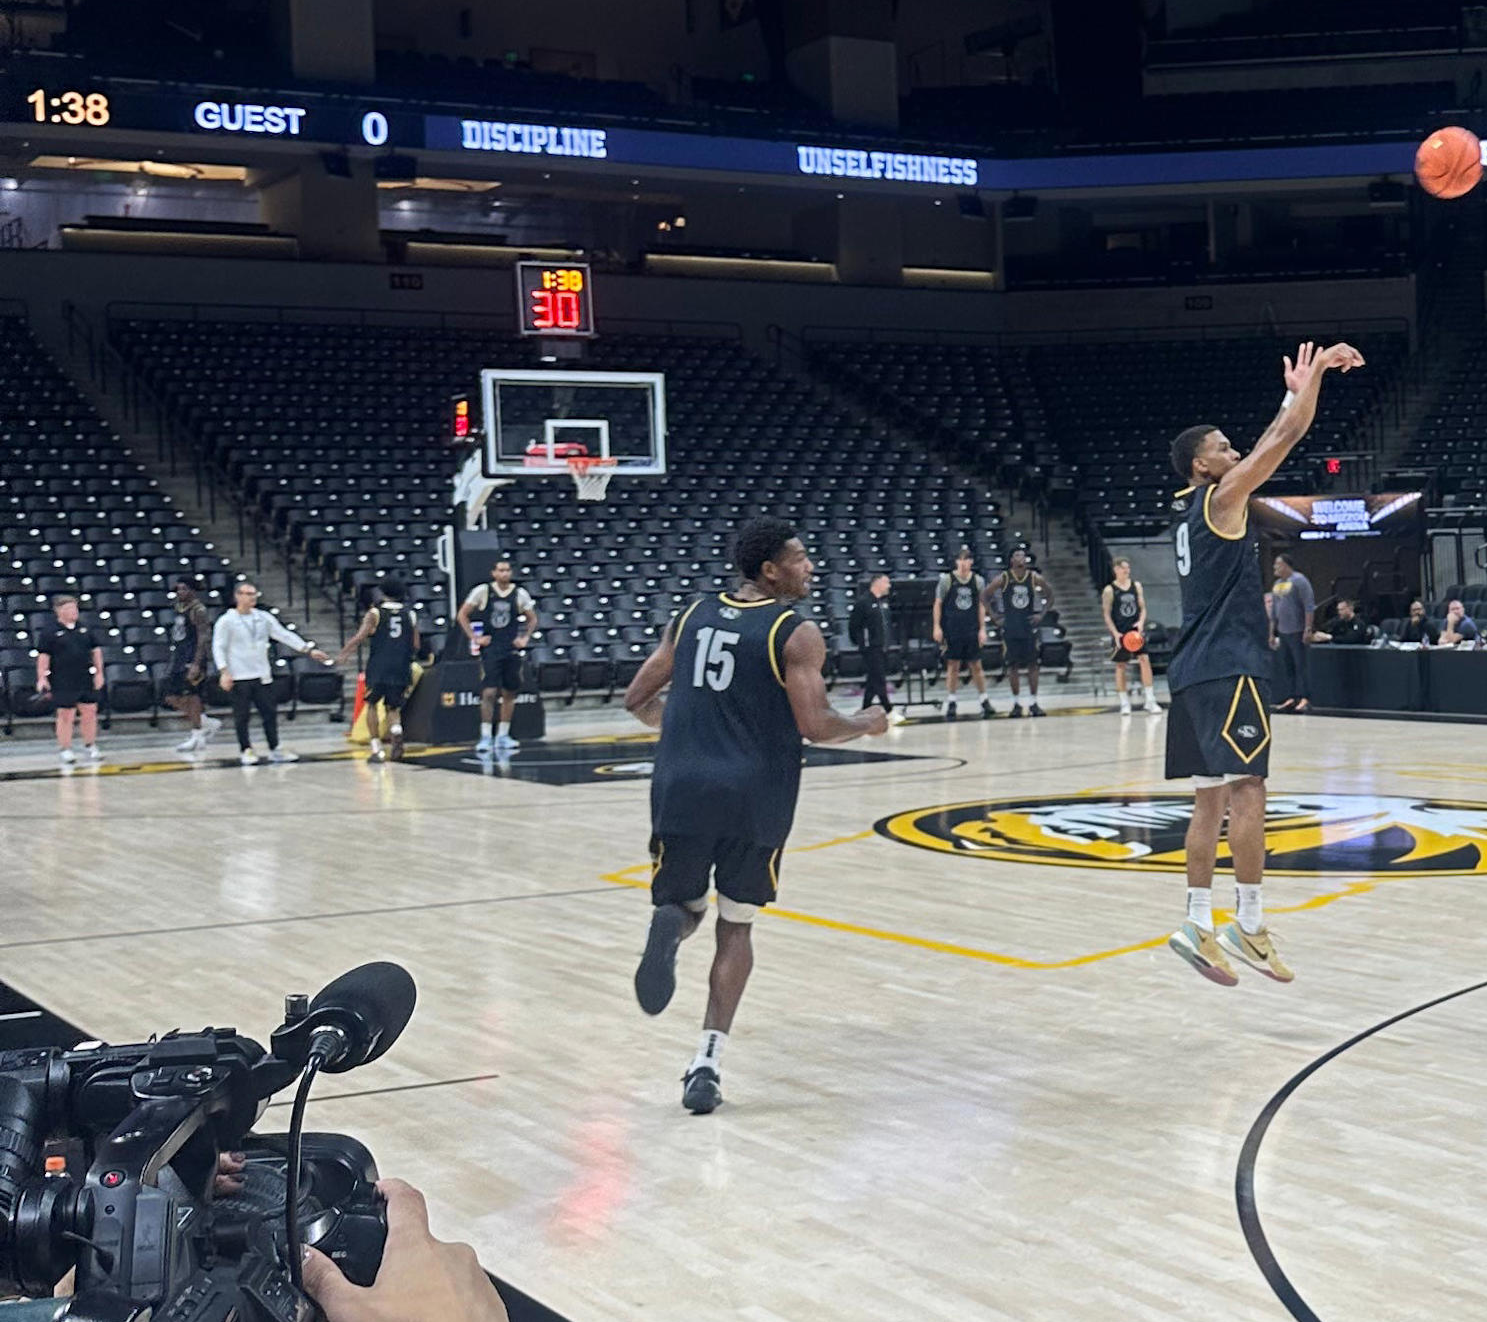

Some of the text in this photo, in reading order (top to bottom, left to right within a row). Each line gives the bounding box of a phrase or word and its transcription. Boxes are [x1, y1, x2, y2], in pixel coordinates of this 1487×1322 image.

[27, 89, 110, 125] 1:38
[194, 101, 306, 134] GUEST
[362, 112, 388, 145] 0
[461, 119, 608, 158] DISCIPLINE
[797, 145, 978, 185] UNSELFISHNESS
[541, 269, 584, 292] 1:38
[531, 290, 580, 328] 30
[1176, 522, 1191, 577] 9
[389, 616, 402, 639] 5
[693, 626, 741, 692] 15
